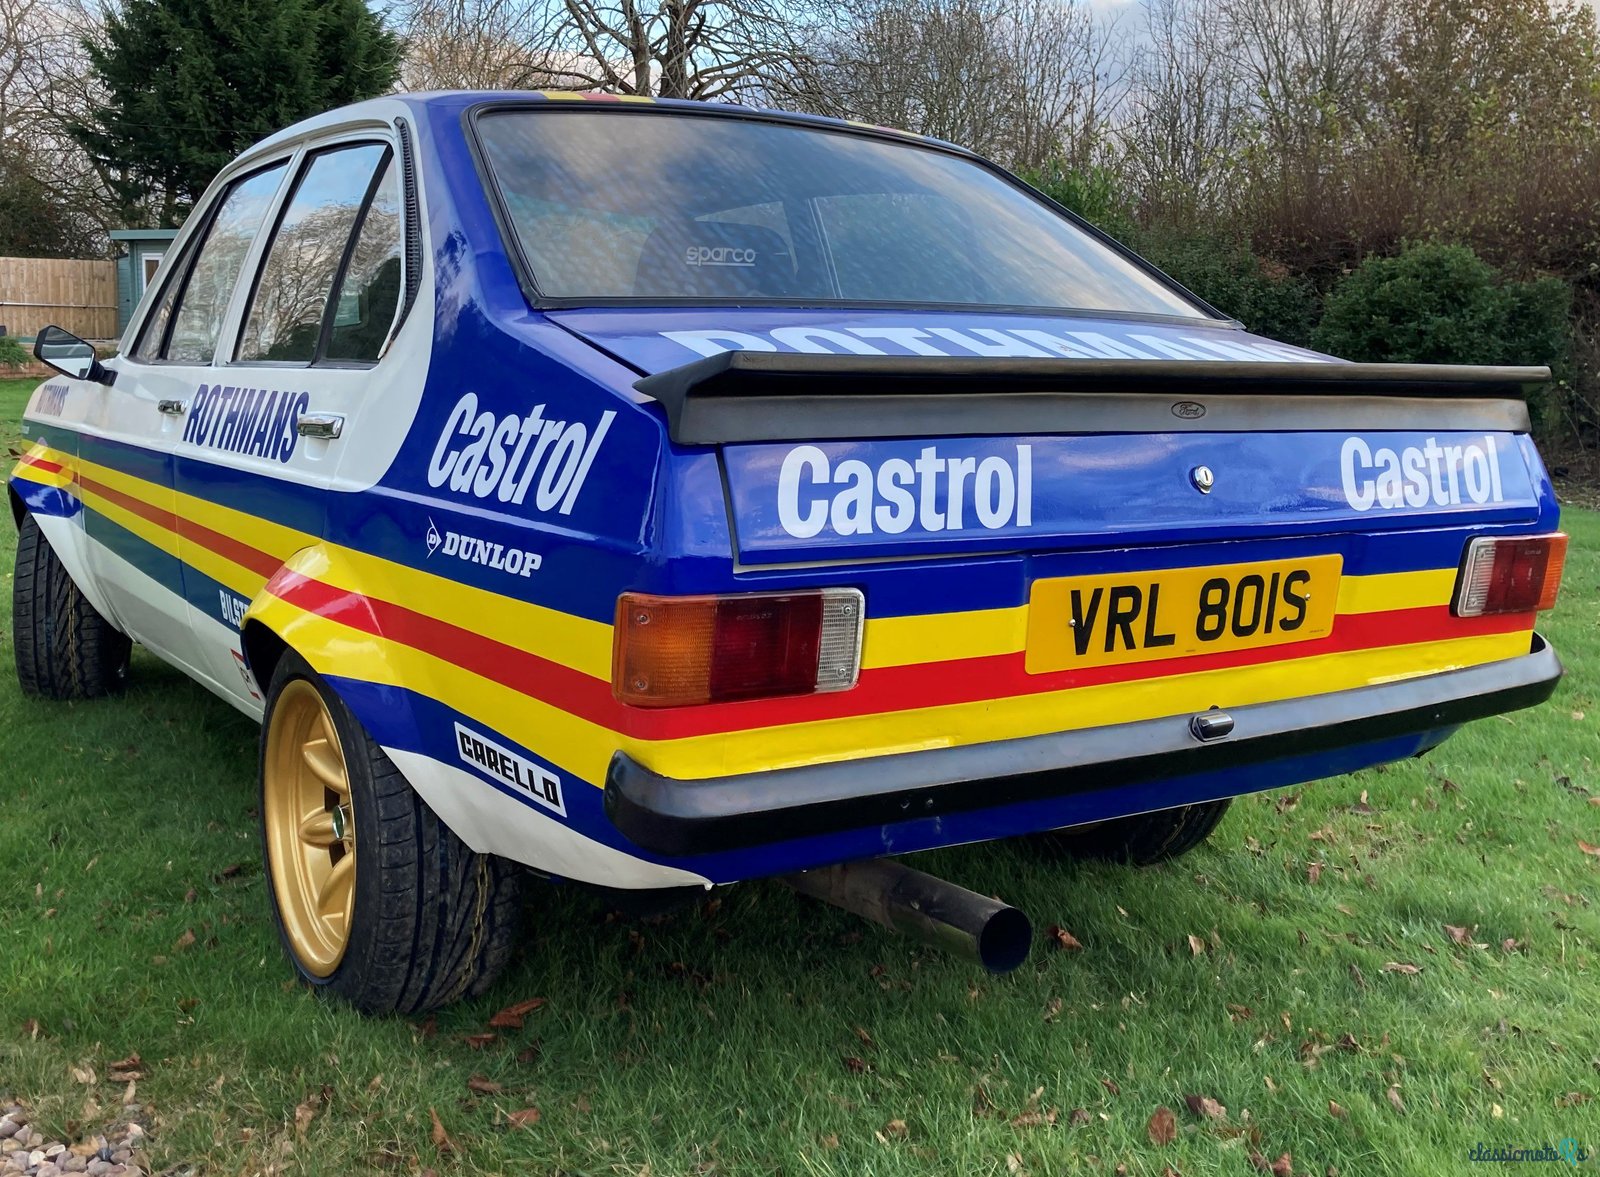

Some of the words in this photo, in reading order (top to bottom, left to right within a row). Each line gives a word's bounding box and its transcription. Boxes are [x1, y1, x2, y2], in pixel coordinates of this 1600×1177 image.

[686, 246, 756, 265] sparco
[183, 384, 309, 463] ROTHMANS
[427, 392, 617, 516] Castrol
[777, 444, 1032, 538] Castrol
[1340, 435, 1503, 511] Castrol
[442, 531, 542, 577] DUNLOP
[1070, 583, 1176, 656] VRL
[1195, 570, 1311, 642] 801S
[459, 730, 560, 808] CARELLO
